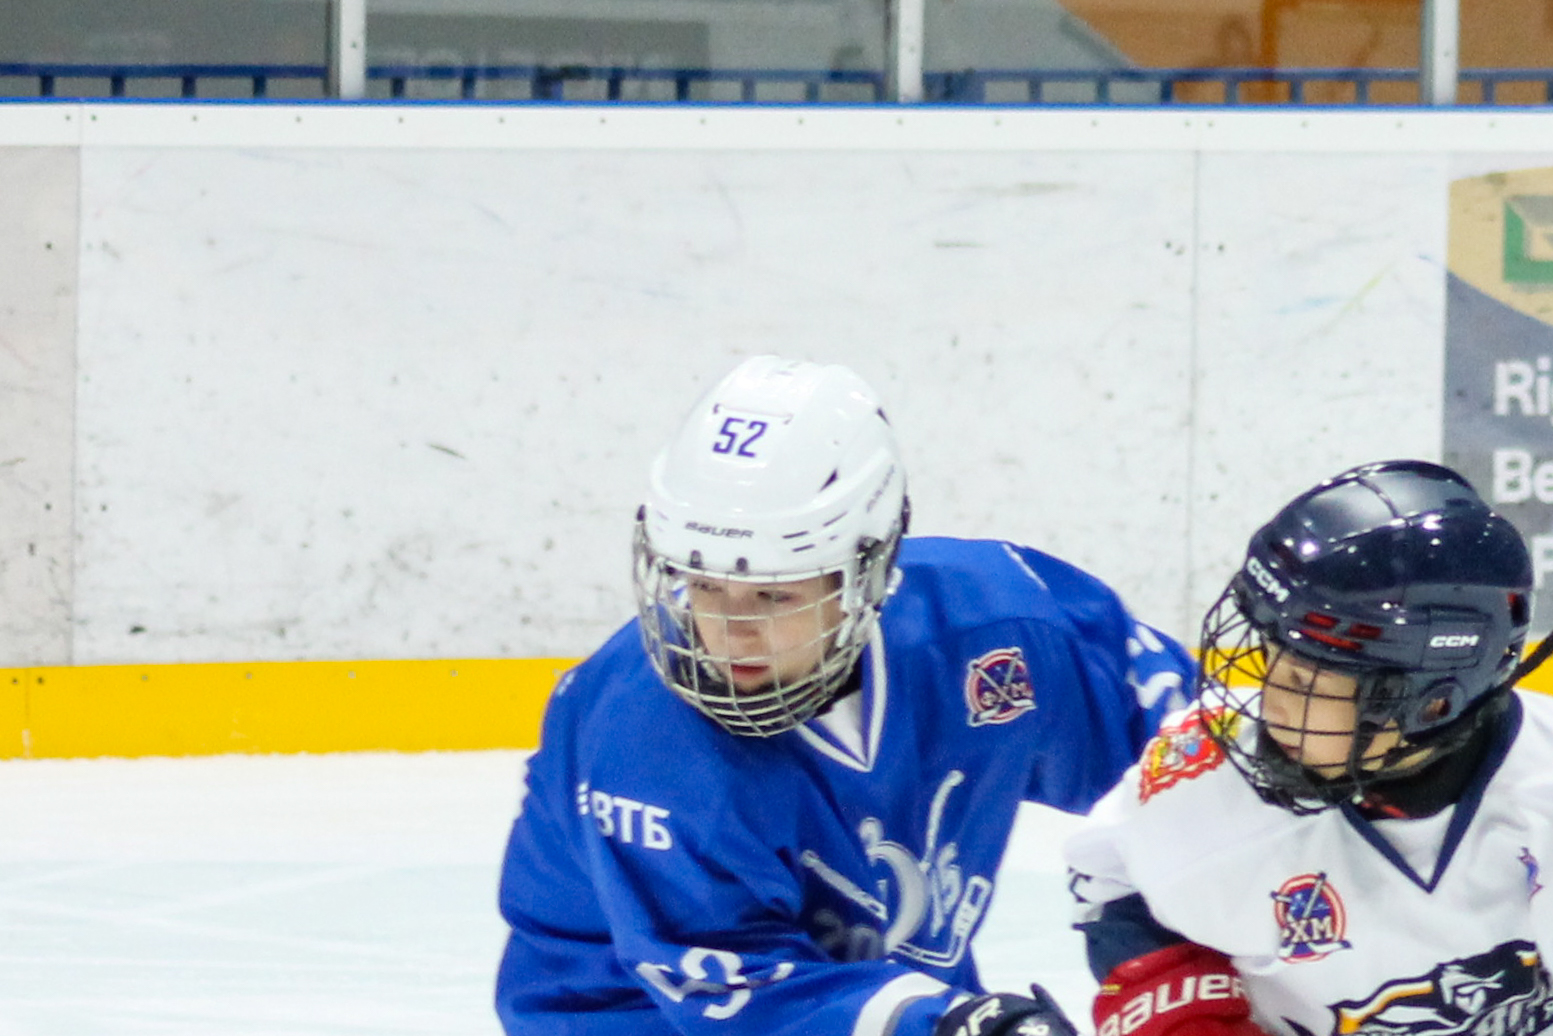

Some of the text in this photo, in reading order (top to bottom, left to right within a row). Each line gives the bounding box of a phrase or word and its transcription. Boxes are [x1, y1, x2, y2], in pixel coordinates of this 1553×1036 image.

[712, 416, 768, 458] 52
[1247, 556, 1290, 602] CCM
[1430, 634, 1480, 648] CCM
[591, 790, 674, 852] ВТБ
